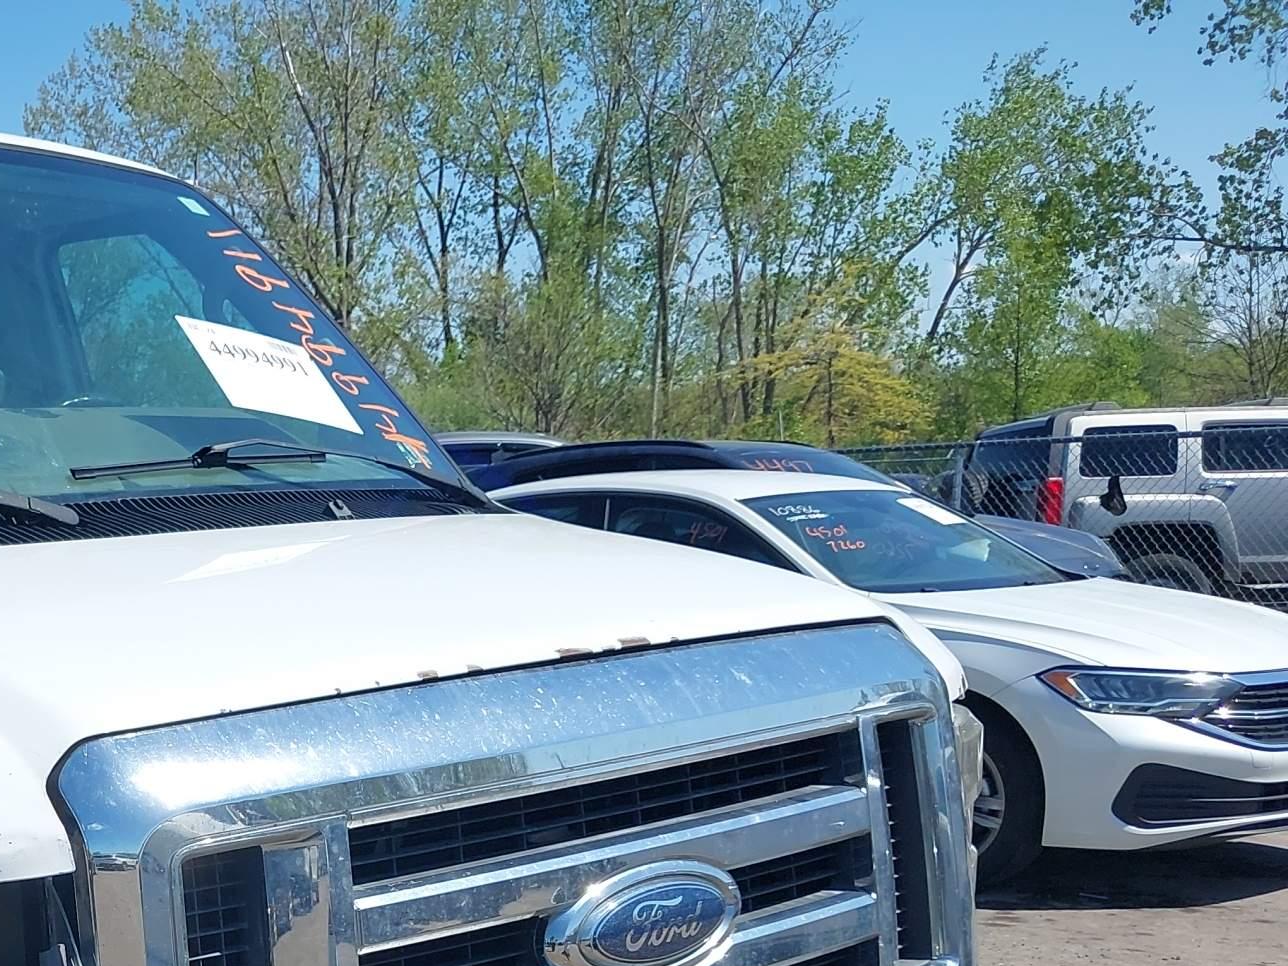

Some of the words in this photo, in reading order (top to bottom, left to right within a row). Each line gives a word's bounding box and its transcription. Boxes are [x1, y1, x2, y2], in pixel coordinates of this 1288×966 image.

[209, 340, 310, 377] 44994991
[805, 524, 848, 540] 4501
[825, 540, 866, 553] 7260
[625, 895, 704, 953] Ford
